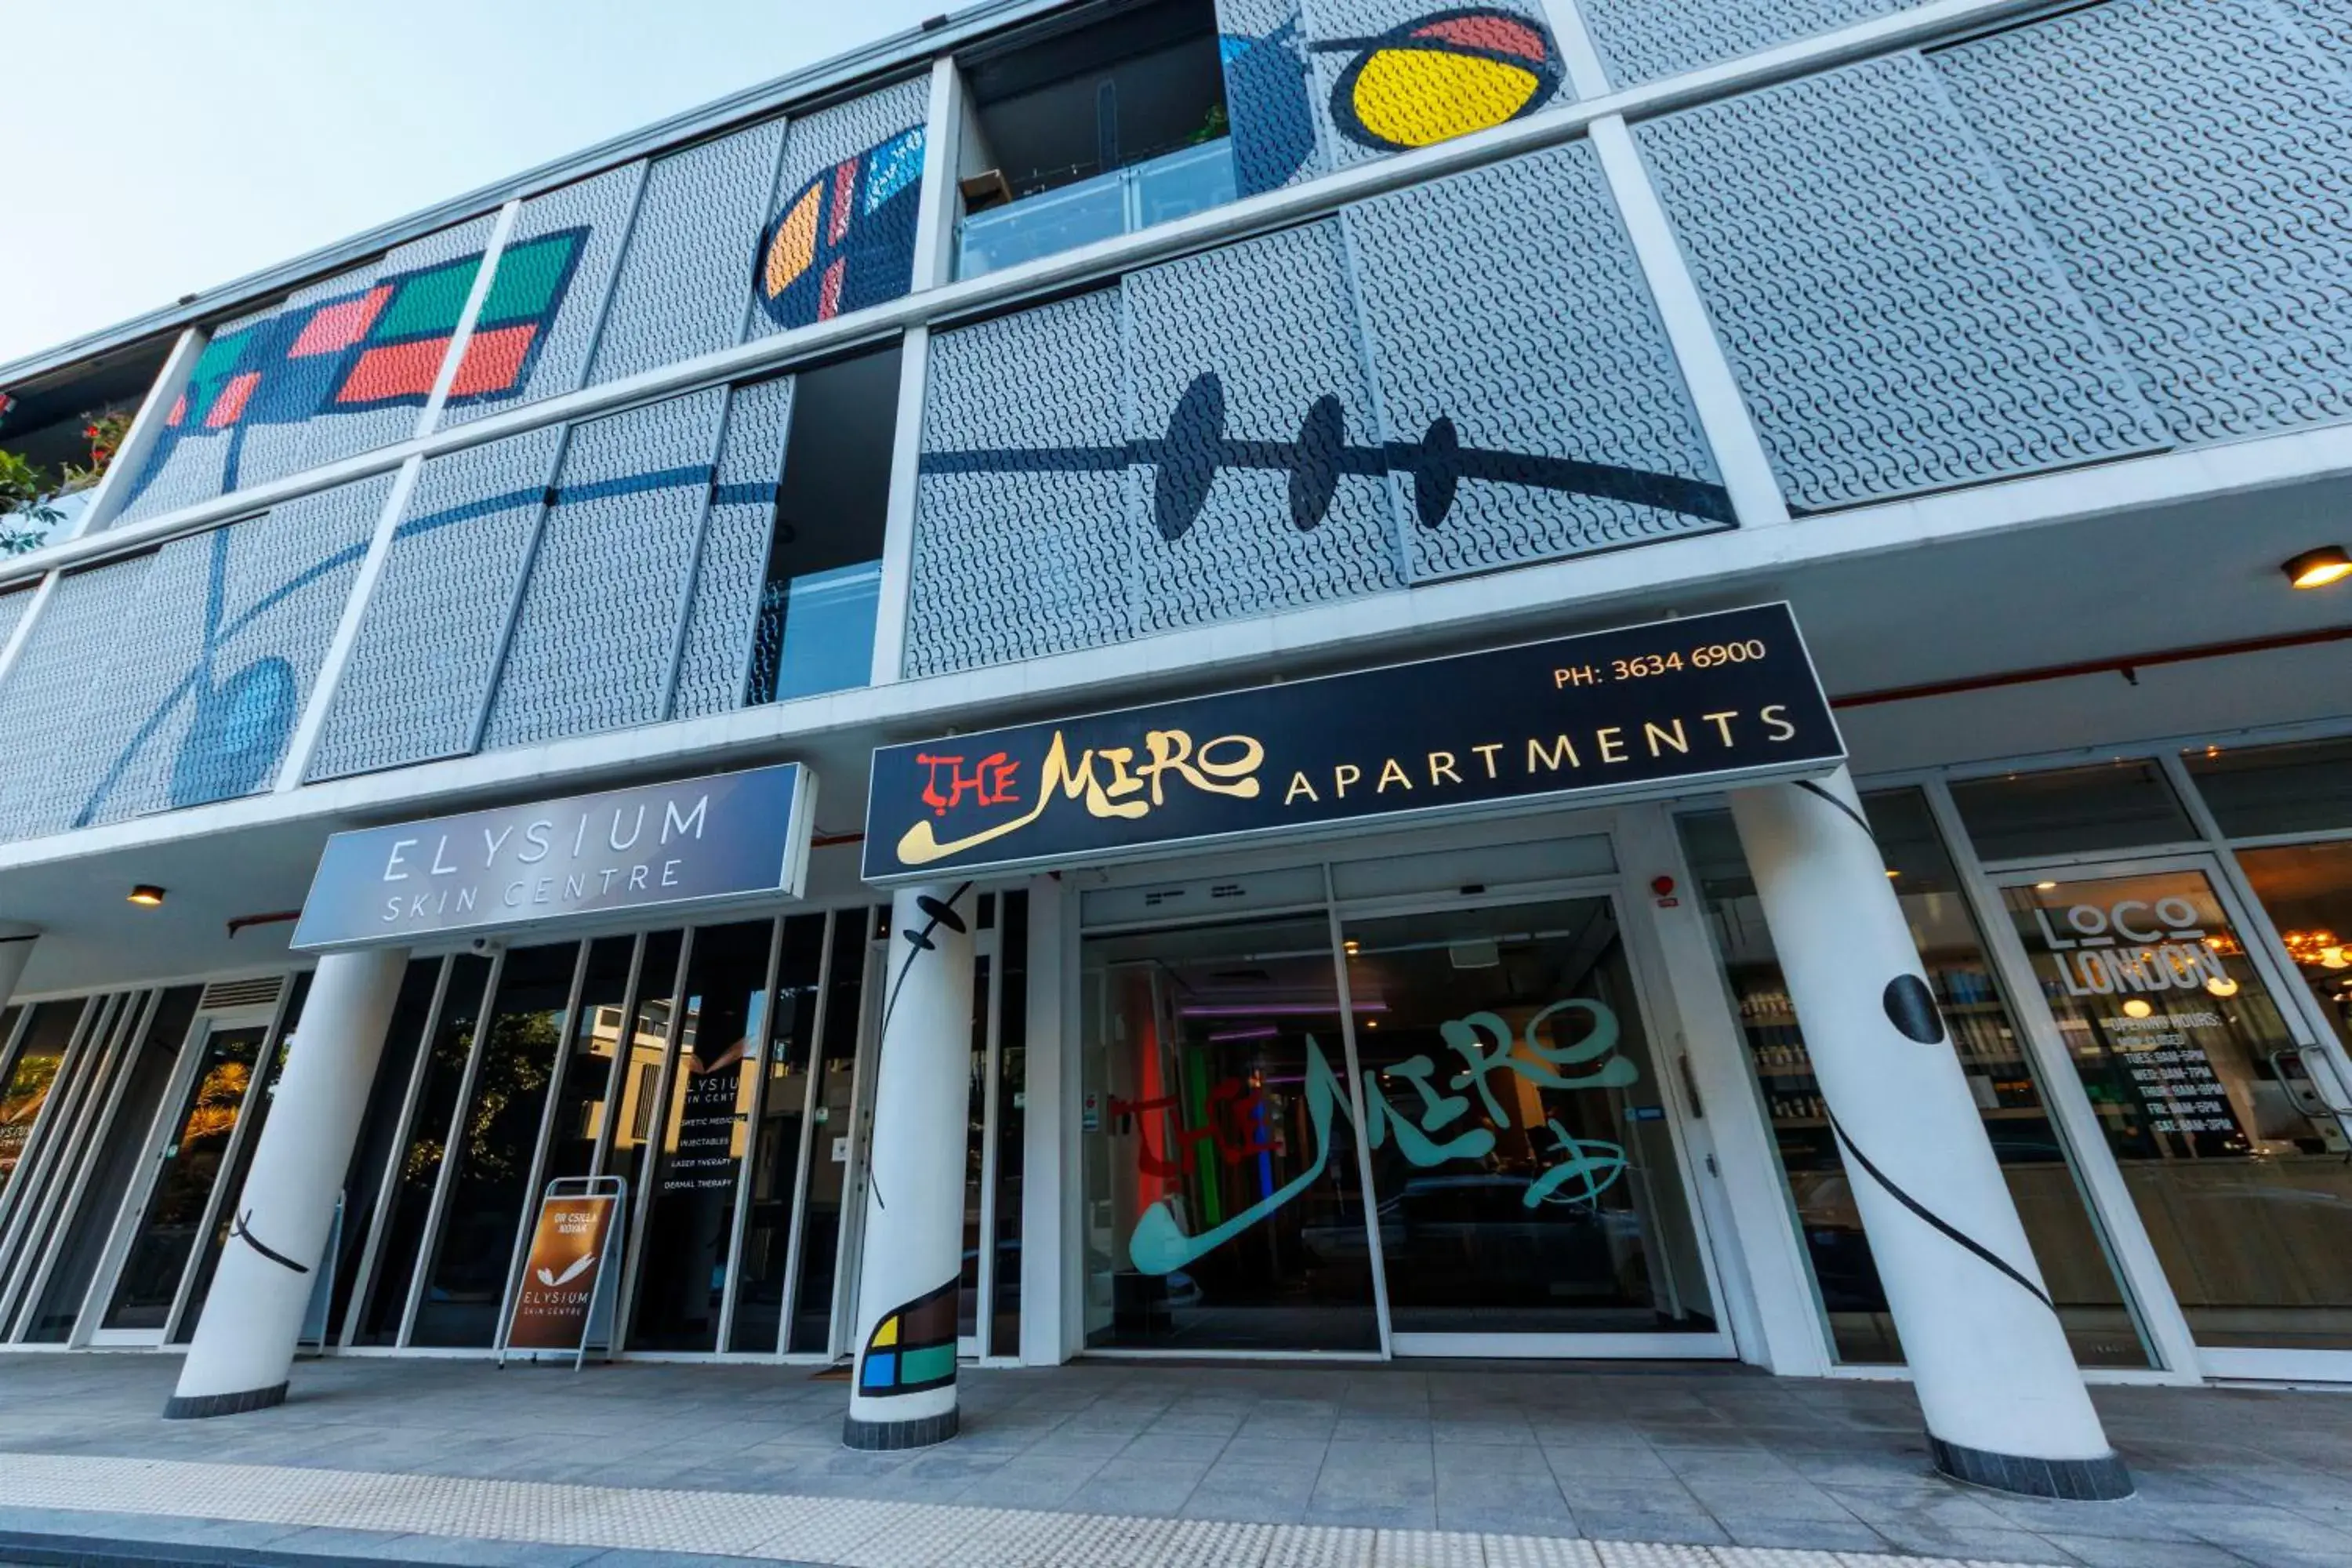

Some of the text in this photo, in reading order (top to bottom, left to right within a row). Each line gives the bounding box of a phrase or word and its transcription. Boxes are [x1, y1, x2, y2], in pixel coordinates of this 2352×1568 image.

[1554, 639, 1766, 690] PH: 3634 6900
[916, 752, 1019, 816] THE
[1283, 705, 1796, 805] APARTMENTS
[383, 795, 709, 881] ELYSIUM
[381, 860, 683, 922] SKIN CENTRE
[2035, 898, 2205, 950] LOCO
[2053, 943, 2230, 996] LONDON
[2169, 1012, 2223, 1029] HOURS:
[523, 1291, 589, 1305] ELYSIUM
